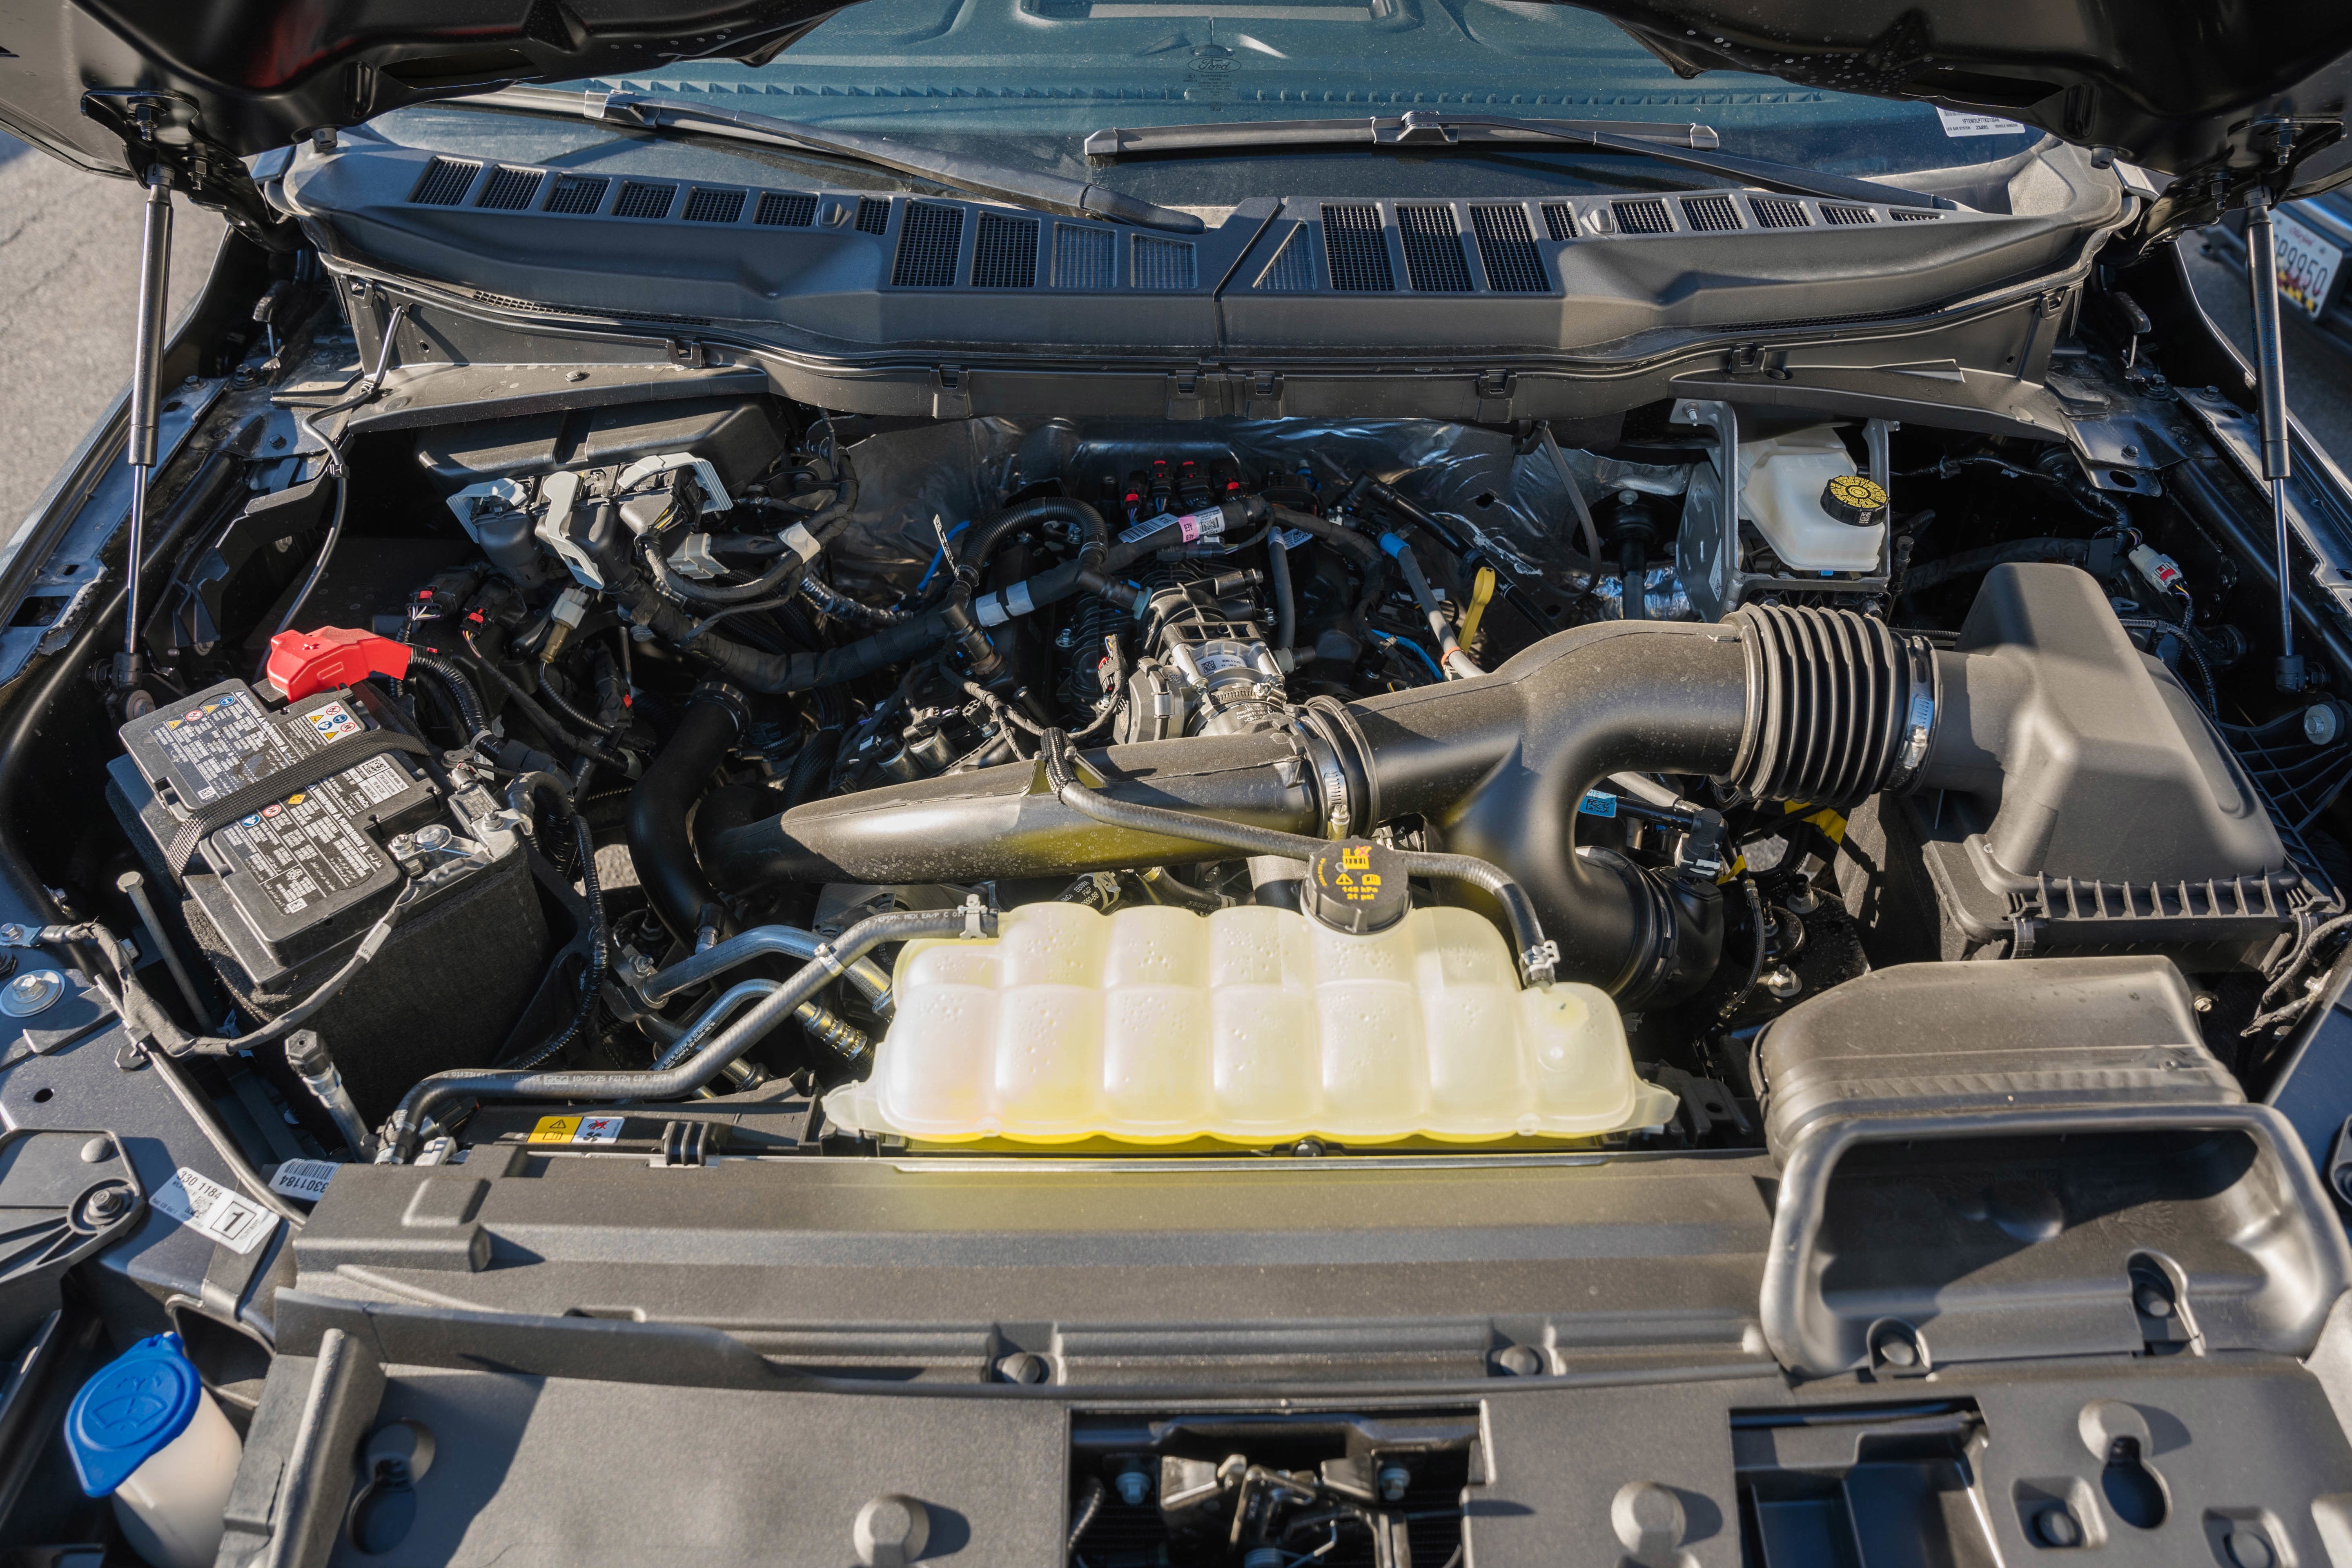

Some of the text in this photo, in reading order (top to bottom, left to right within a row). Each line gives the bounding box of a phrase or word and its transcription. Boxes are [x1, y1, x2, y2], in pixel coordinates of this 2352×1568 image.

[1199, 58, 1230, 70] Ford
[2274, 234, 2328, 296] P9950
[352, 791, 371, 808] FoMoCo
[312, 788, 338, 815] DANGER/POISON
[337, 817, 365, 847] PELIGRO/VENENO
[177, 1169, 199, 1187] 330
[197, 1180, 224, 1201] 1184
[278, 1174, 329, 1193] 3301184
[223, 1208, 246, 1233] 1
